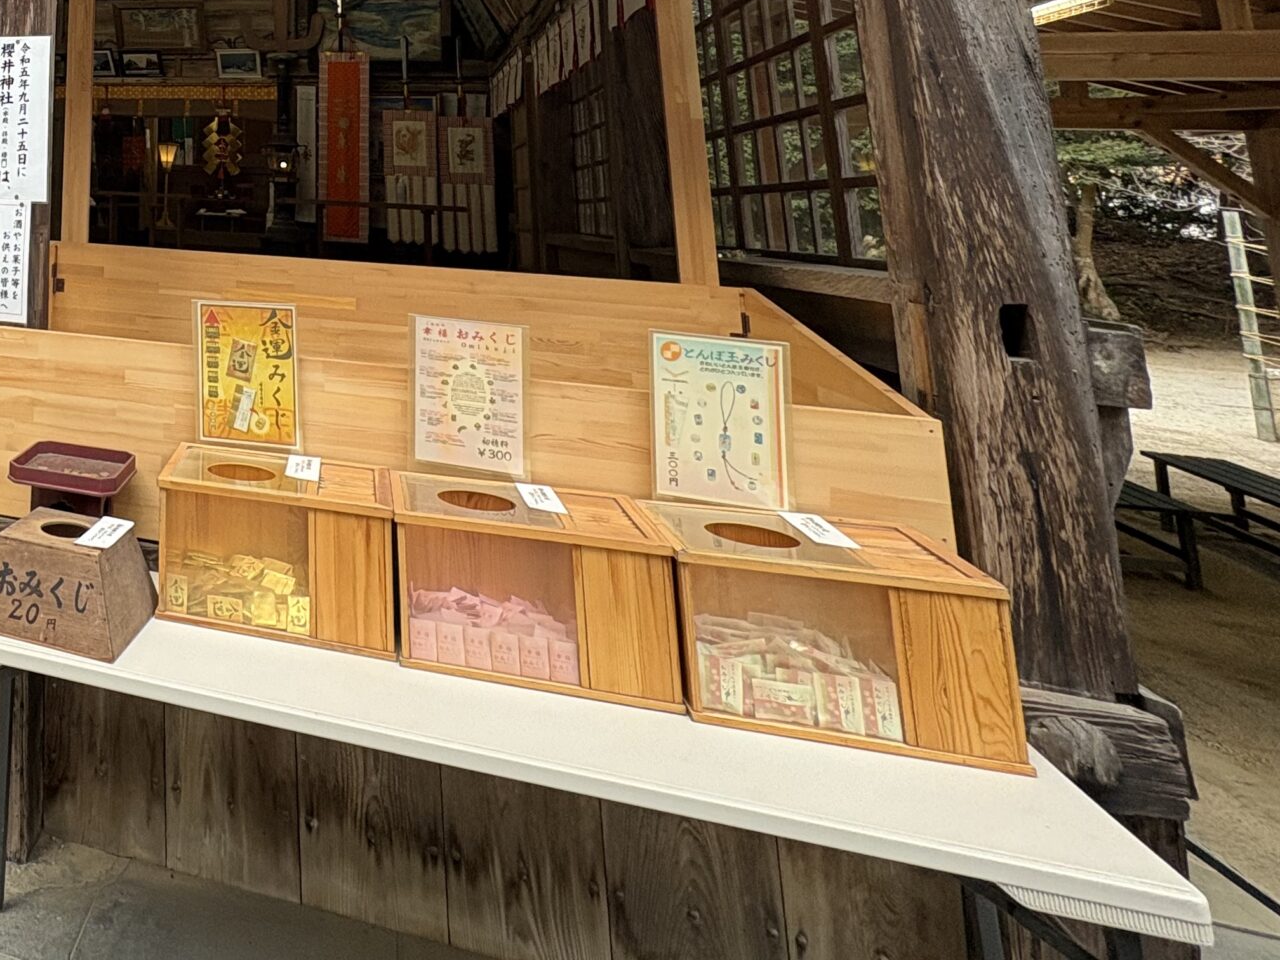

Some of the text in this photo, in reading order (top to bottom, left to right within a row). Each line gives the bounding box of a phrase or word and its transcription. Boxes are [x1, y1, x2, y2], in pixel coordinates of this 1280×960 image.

[17, 42, 30, 178] 令和五年九月二十五日に
[0, 230, 11, 310] お供えの皆様へ
[12, 208, 23, 301] お酒やお菓子等を
[259, 309, 294, 431] 金運みくじ
[456, 328, 517, 346] おみくじ
[683, 346, 778, 368] とんぼ玉みくじ
[477, 447, 512, 461] ¥300
